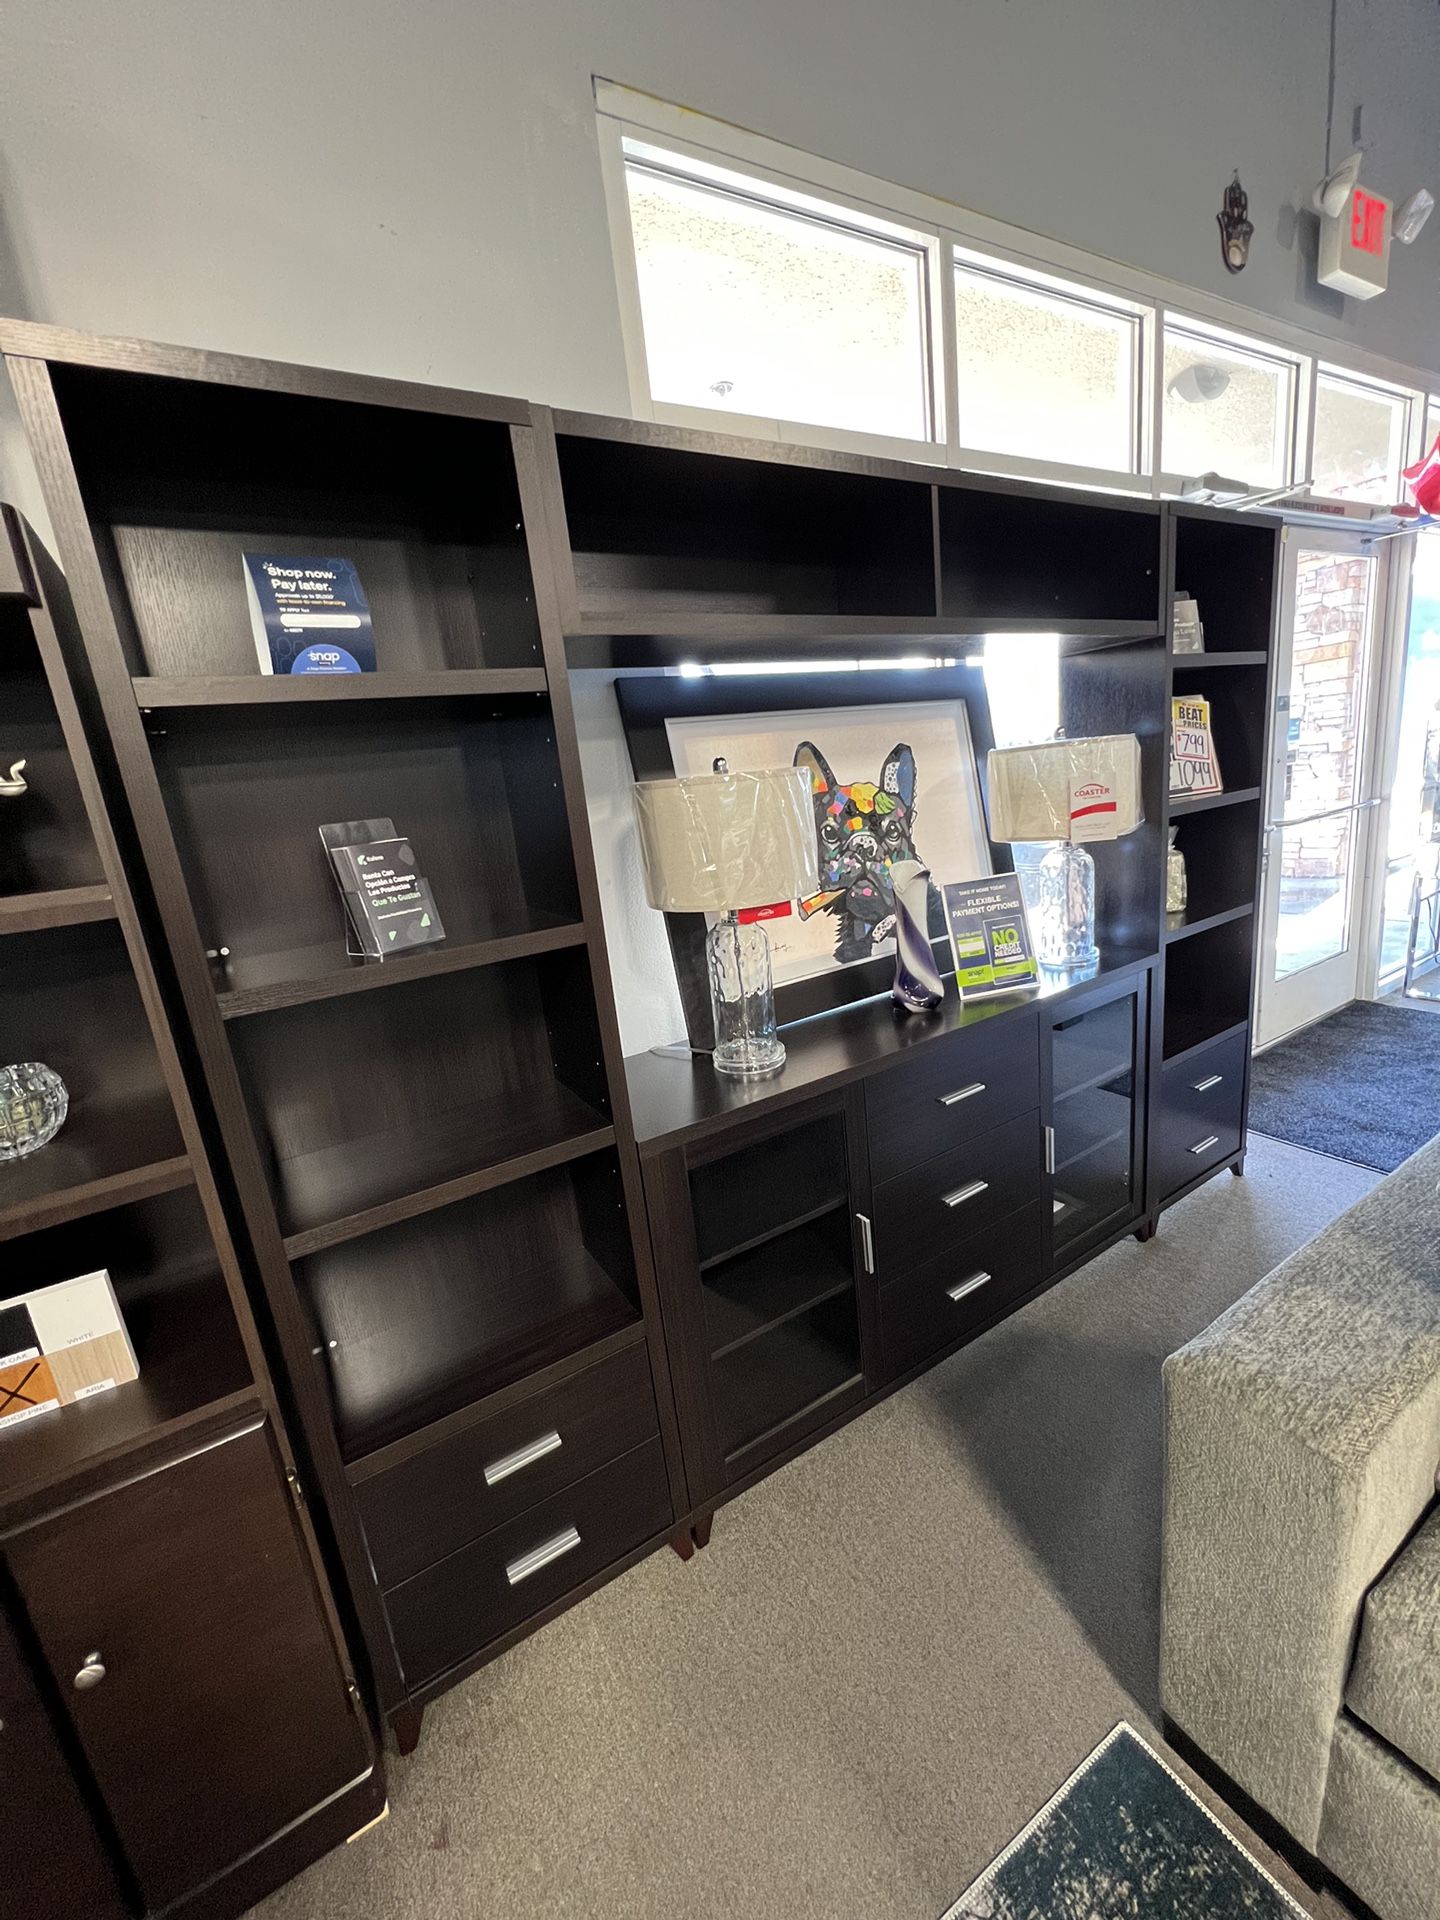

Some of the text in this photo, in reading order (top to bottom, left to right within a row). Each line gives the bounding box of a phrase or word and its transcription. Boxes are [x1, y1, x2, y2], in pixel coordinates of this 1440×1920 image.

[1351, 188, 1387, 257] EXIT
[267, 566, 336, 579] Shop now.
[271, 579, 332, 591] Pay later.
[308, 651, 341, 664] snap
[1178, 706, 1204, 721] BEAT
[1183, 720, 1208, 730] PRICES
[1074, 788, 1110, 797] COASTER
[372, 898, 388, 907] Que
[397, 892, 421, 901] Gustan
[967, 895, 1002, 906] FLEXIBLE
[952, 900, 1019, 918] PAYMENT OPTIONS!
[991, 928, 1019, 945] NO
[994, 941, 1020, 952] CREDIT
[994, 948, 1023, 958] NEEDED
[67, 1331, 94, 1345] WHITE
[8, 1353, 28, 1365] OAK
[86, 1383, 106, 1394] ARIA
[28, 1404, 48, 1415] PINE
